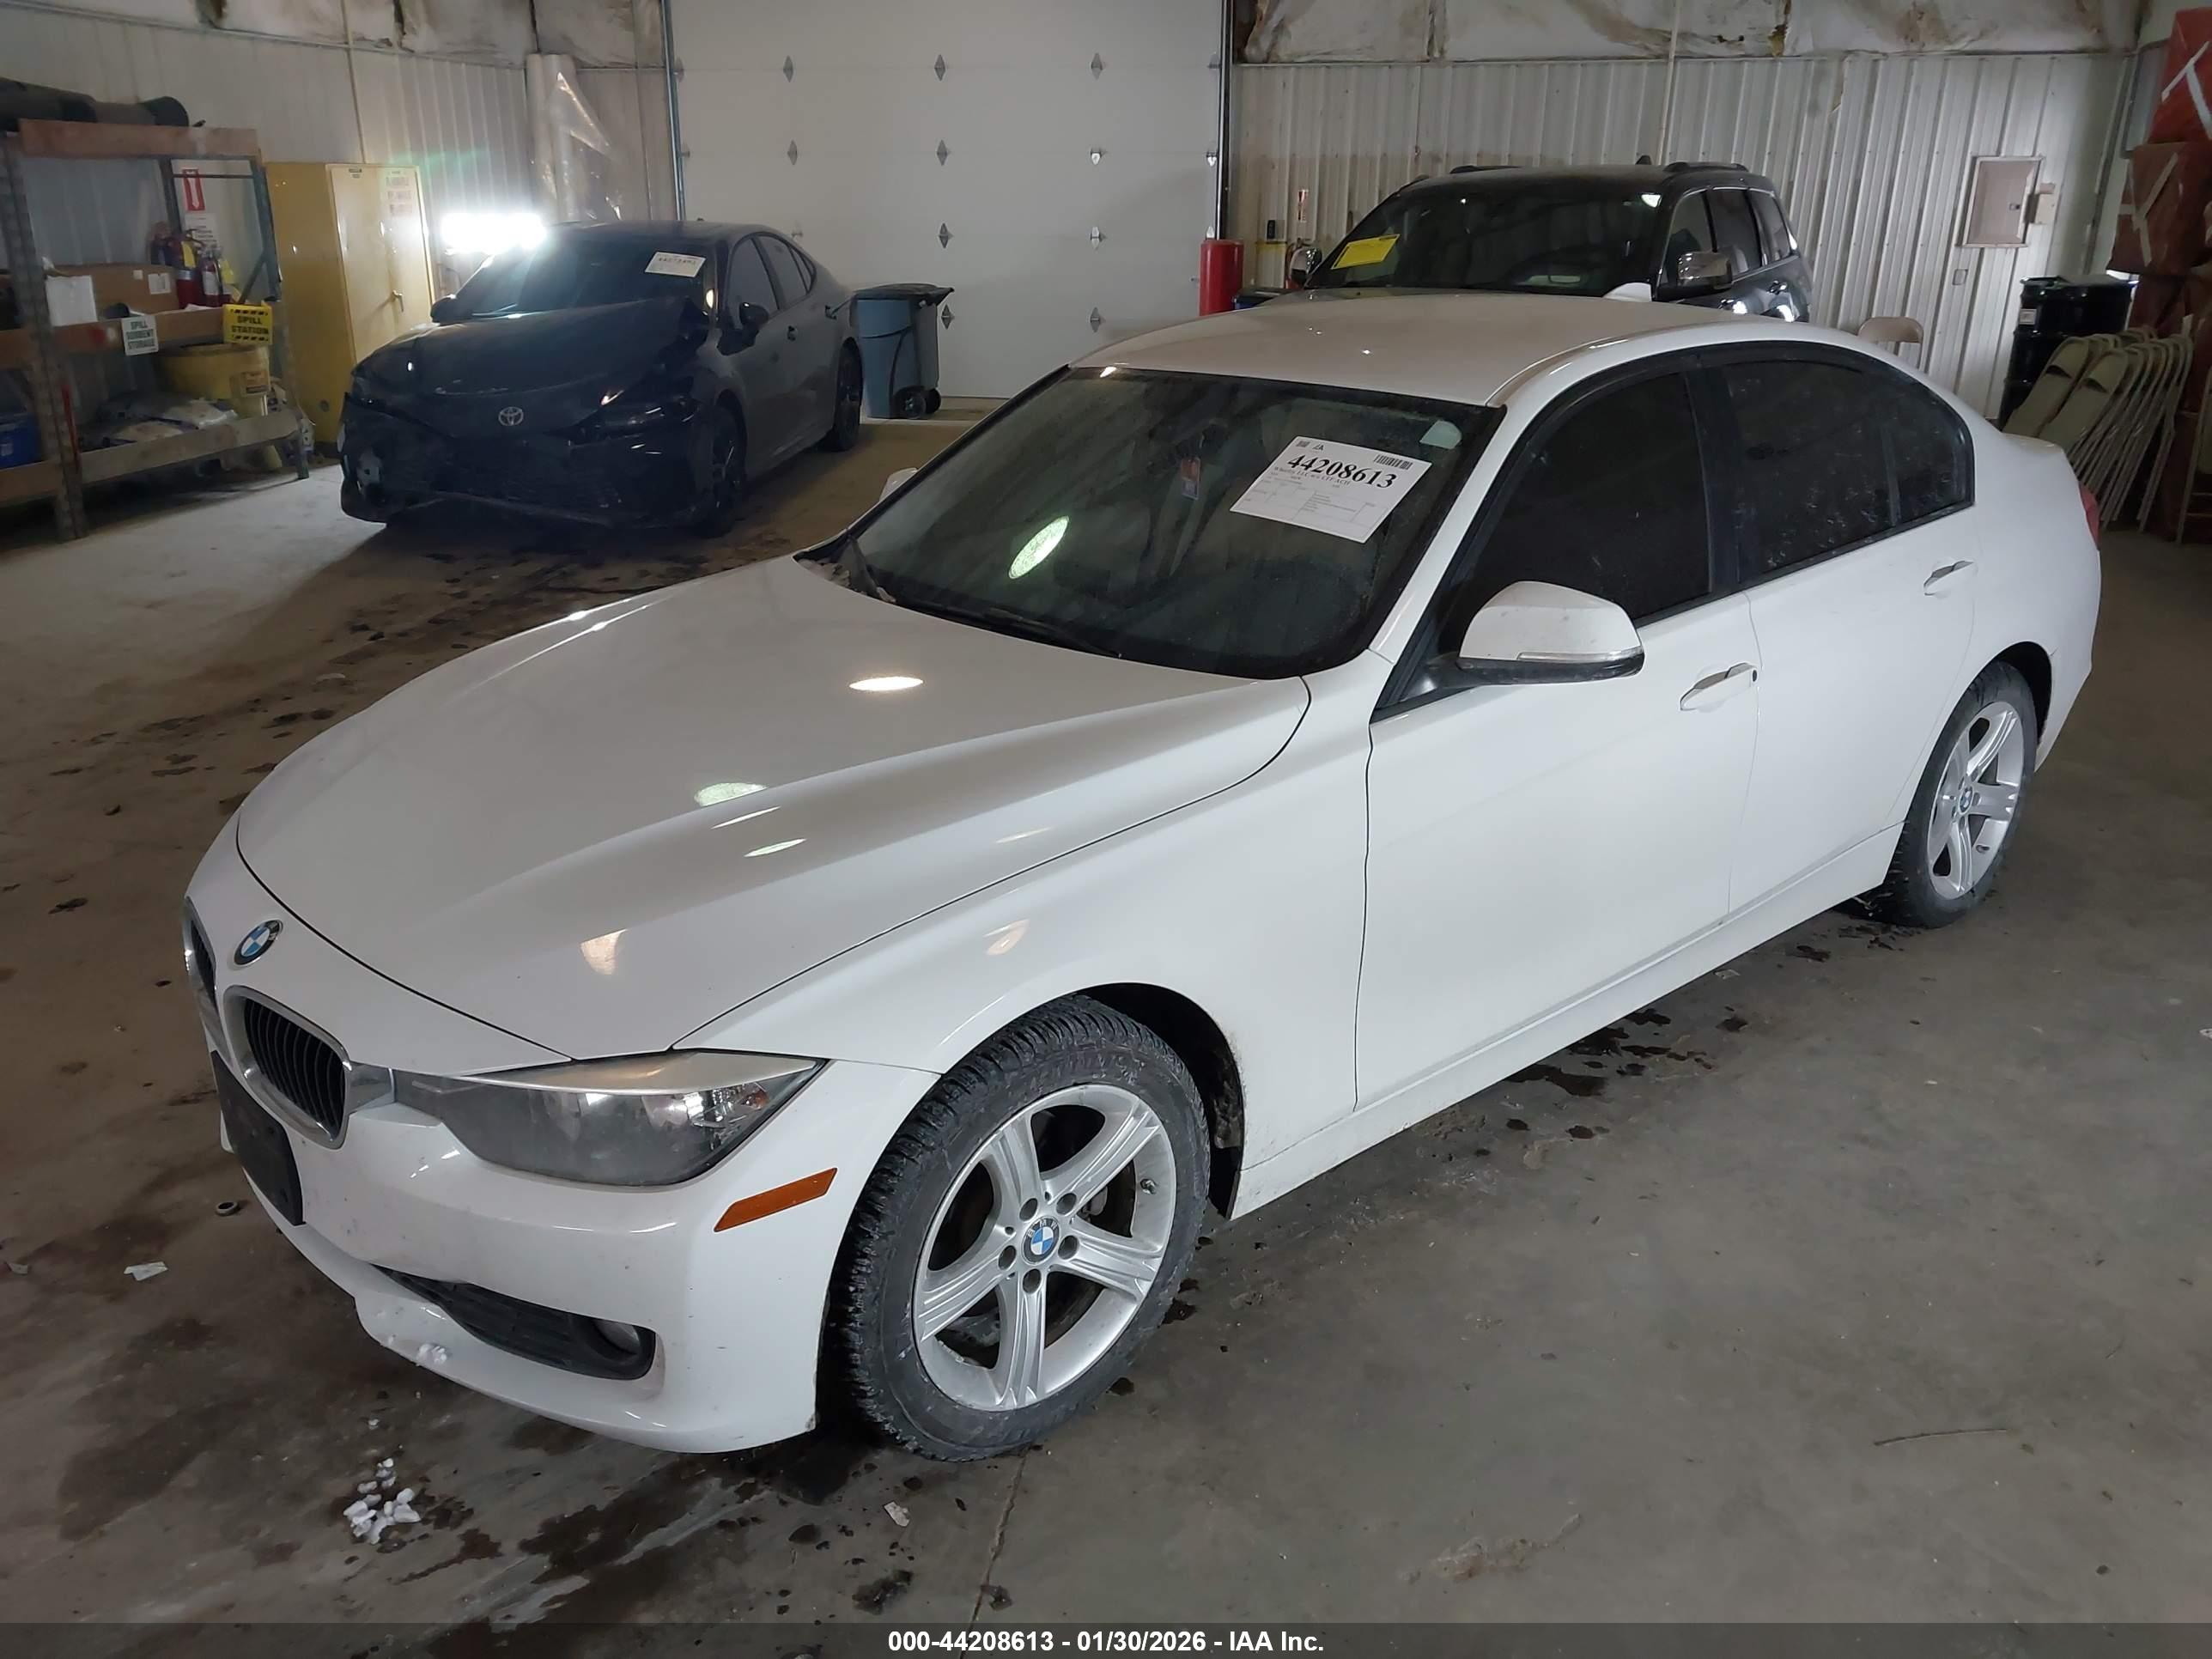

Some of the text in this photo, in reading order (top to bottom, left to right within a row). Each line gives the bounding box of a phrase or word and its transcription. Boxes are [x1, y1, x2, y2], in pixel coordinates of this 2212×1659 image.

[236, 316, 262, 325] SPILL
[232, 325, 269, 335] STATION
[1288, 455, 1397, 489] 44208613
[1027, 1218, 1057, 1238] BMW
